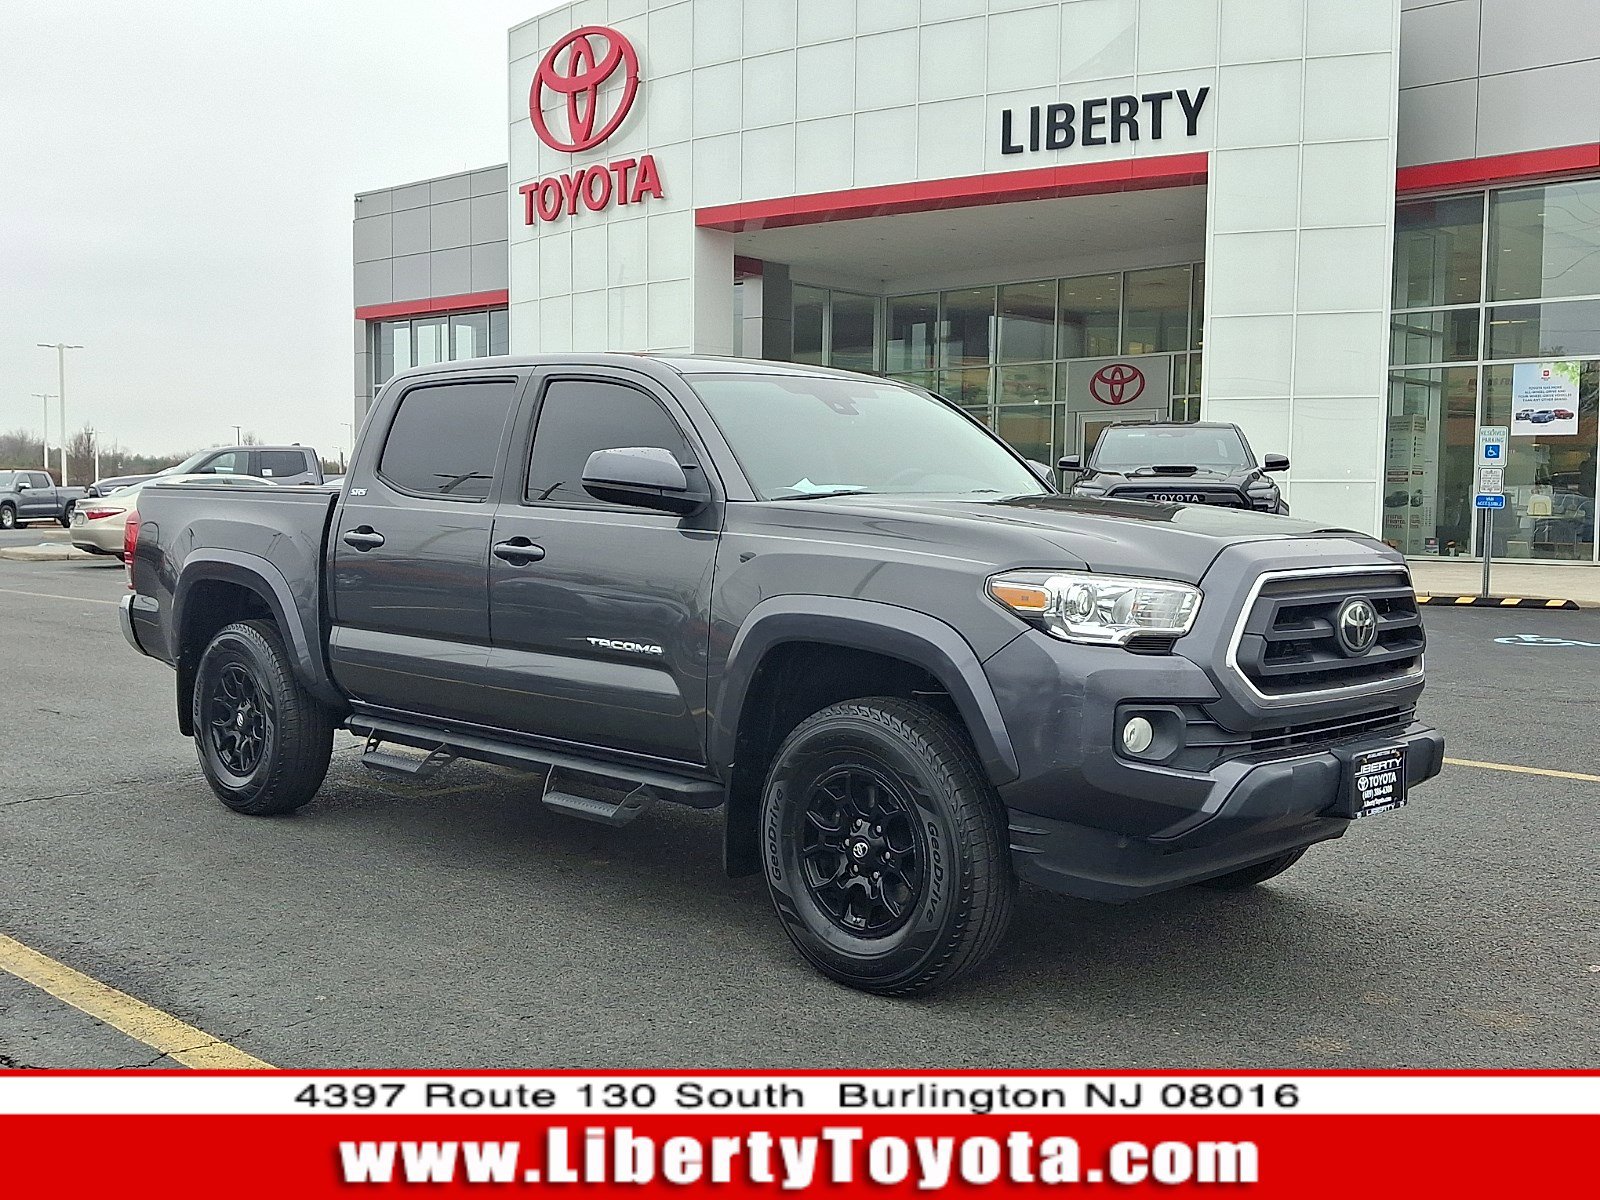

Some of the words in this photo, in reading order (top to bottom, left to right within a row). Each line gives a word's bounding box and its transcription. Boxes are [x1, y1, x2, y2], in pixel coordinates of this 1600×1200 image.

[1001, 86, 1210, 155] LIBERTY
[518, 154, 665, 226] TOYOTA
[350, 488, 368, 496] SR5
[1152, 493, 1200, 503] TOYOTA
[586, 637, 664, 655] TACOMA
[1354, 757, 1403, 776] LIBERTY
[1369, 771, 1397, 788] TOYOTA
[1366, 804, 1395, 816] LIBERTY
[769, 787, 784, 882] GeoDrive
[927, 821, 945, 924] GeoDrive
